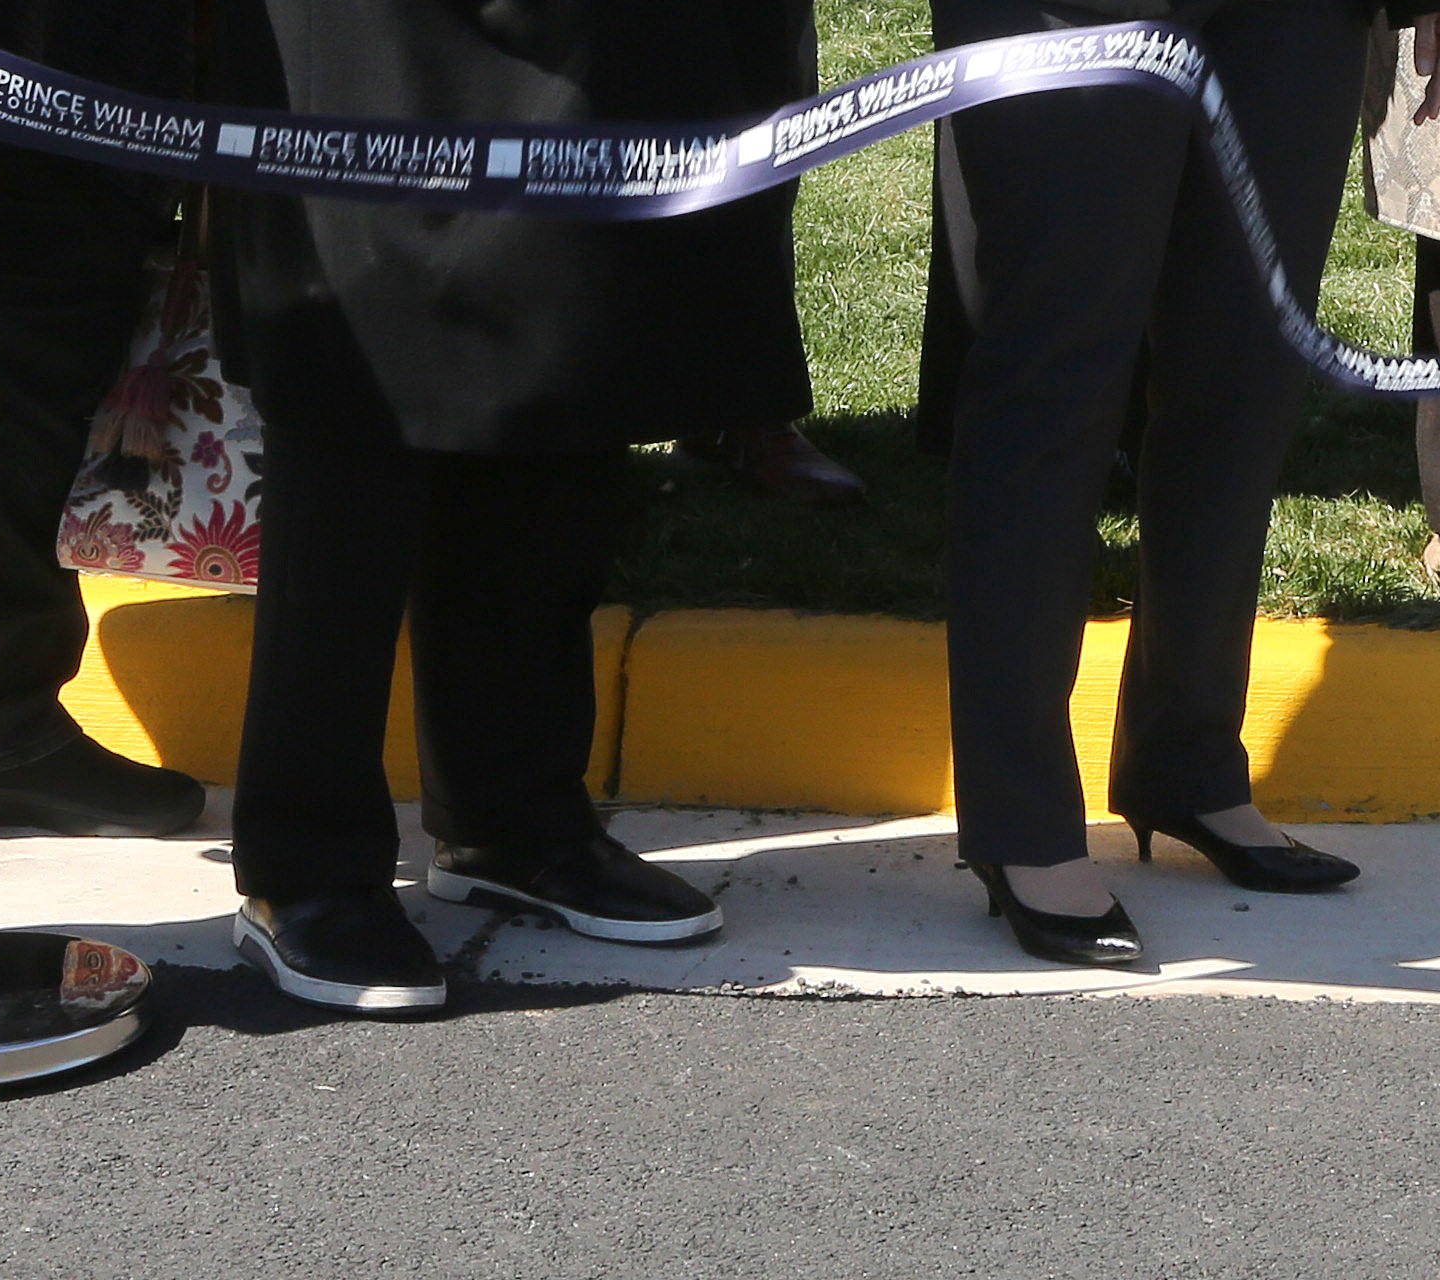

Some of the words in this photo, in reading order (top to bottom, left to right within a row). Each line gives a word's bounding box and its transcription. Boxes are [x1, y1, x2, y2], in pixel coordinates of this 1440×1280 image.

[94, 99, 206, 139] WILLIAM
[95, 120, 202, 150] VIRGINIA
[55, 125, 71, 138] OF
[71, 130, 124, 149] ECONOMIC
[126, 142, 200, 162] DEVELOPMENT
[261, 126, 358, 157] PRINCE
[366, 133, 476, 161] WILLIAM
